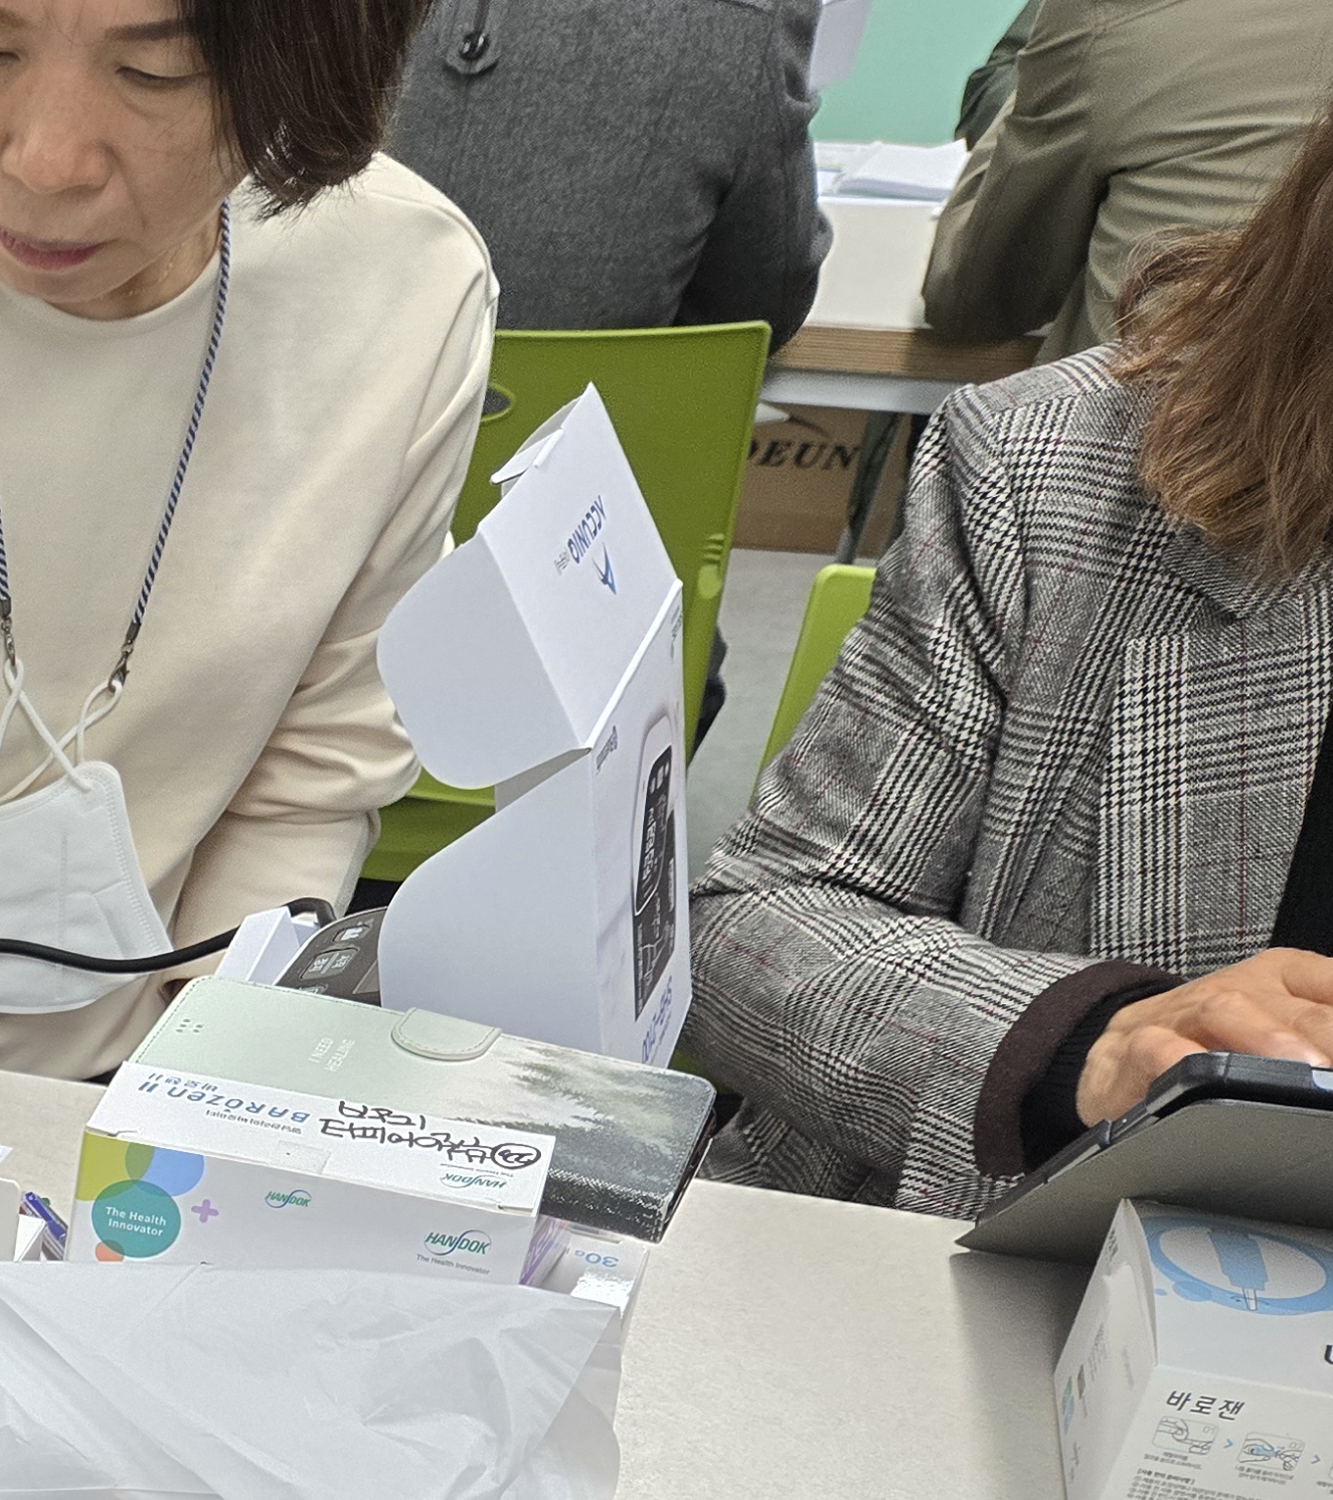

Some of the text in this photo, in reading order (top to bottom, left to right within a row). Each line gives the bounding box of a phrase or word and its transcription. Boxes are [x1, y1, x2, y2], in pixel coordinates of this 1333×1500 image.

[106, 1206, 167, 1227] The Health
[108, 1219, 164, 1237] Innovator
[416, 1254, 430, 1263] The
[431, 1257, 454, 1268] Health
